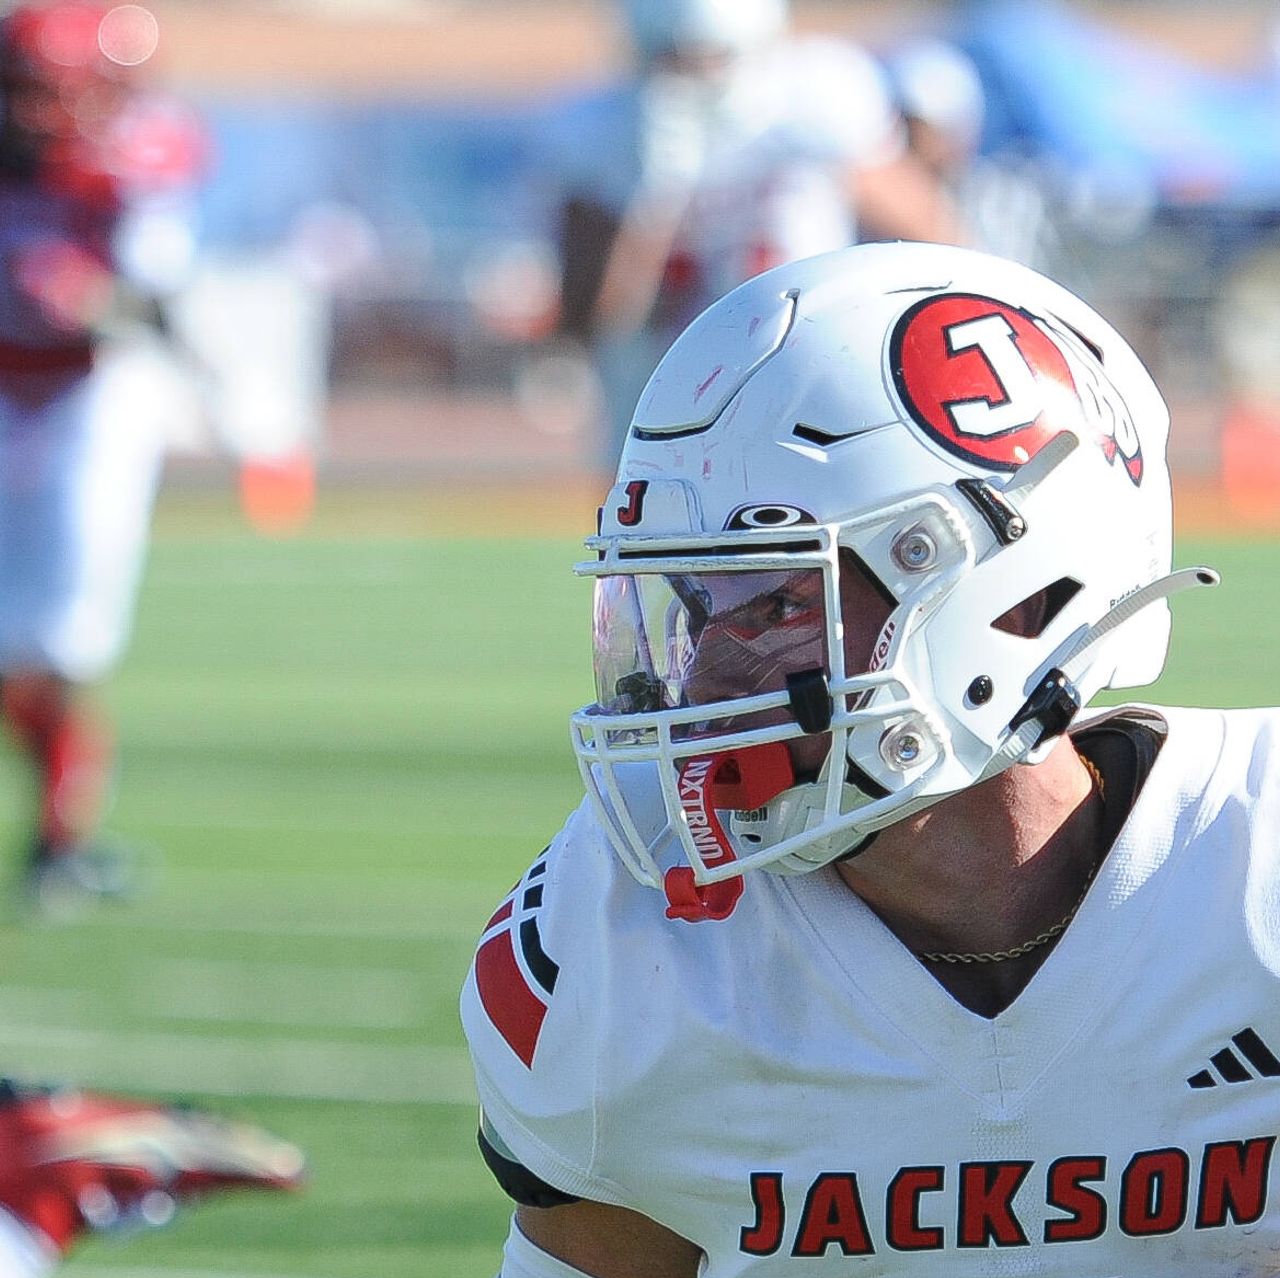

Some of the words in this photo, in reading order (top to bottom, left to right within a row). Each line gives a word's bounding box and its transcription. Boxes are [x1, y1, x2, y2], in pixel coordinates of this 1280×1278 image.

[942, 312, 1046, 442] J
[617, 479, 650, 527] J
[681, 758, 724, 860] NXTRND
[739, 1135, 1278, 1258] JACKSON
